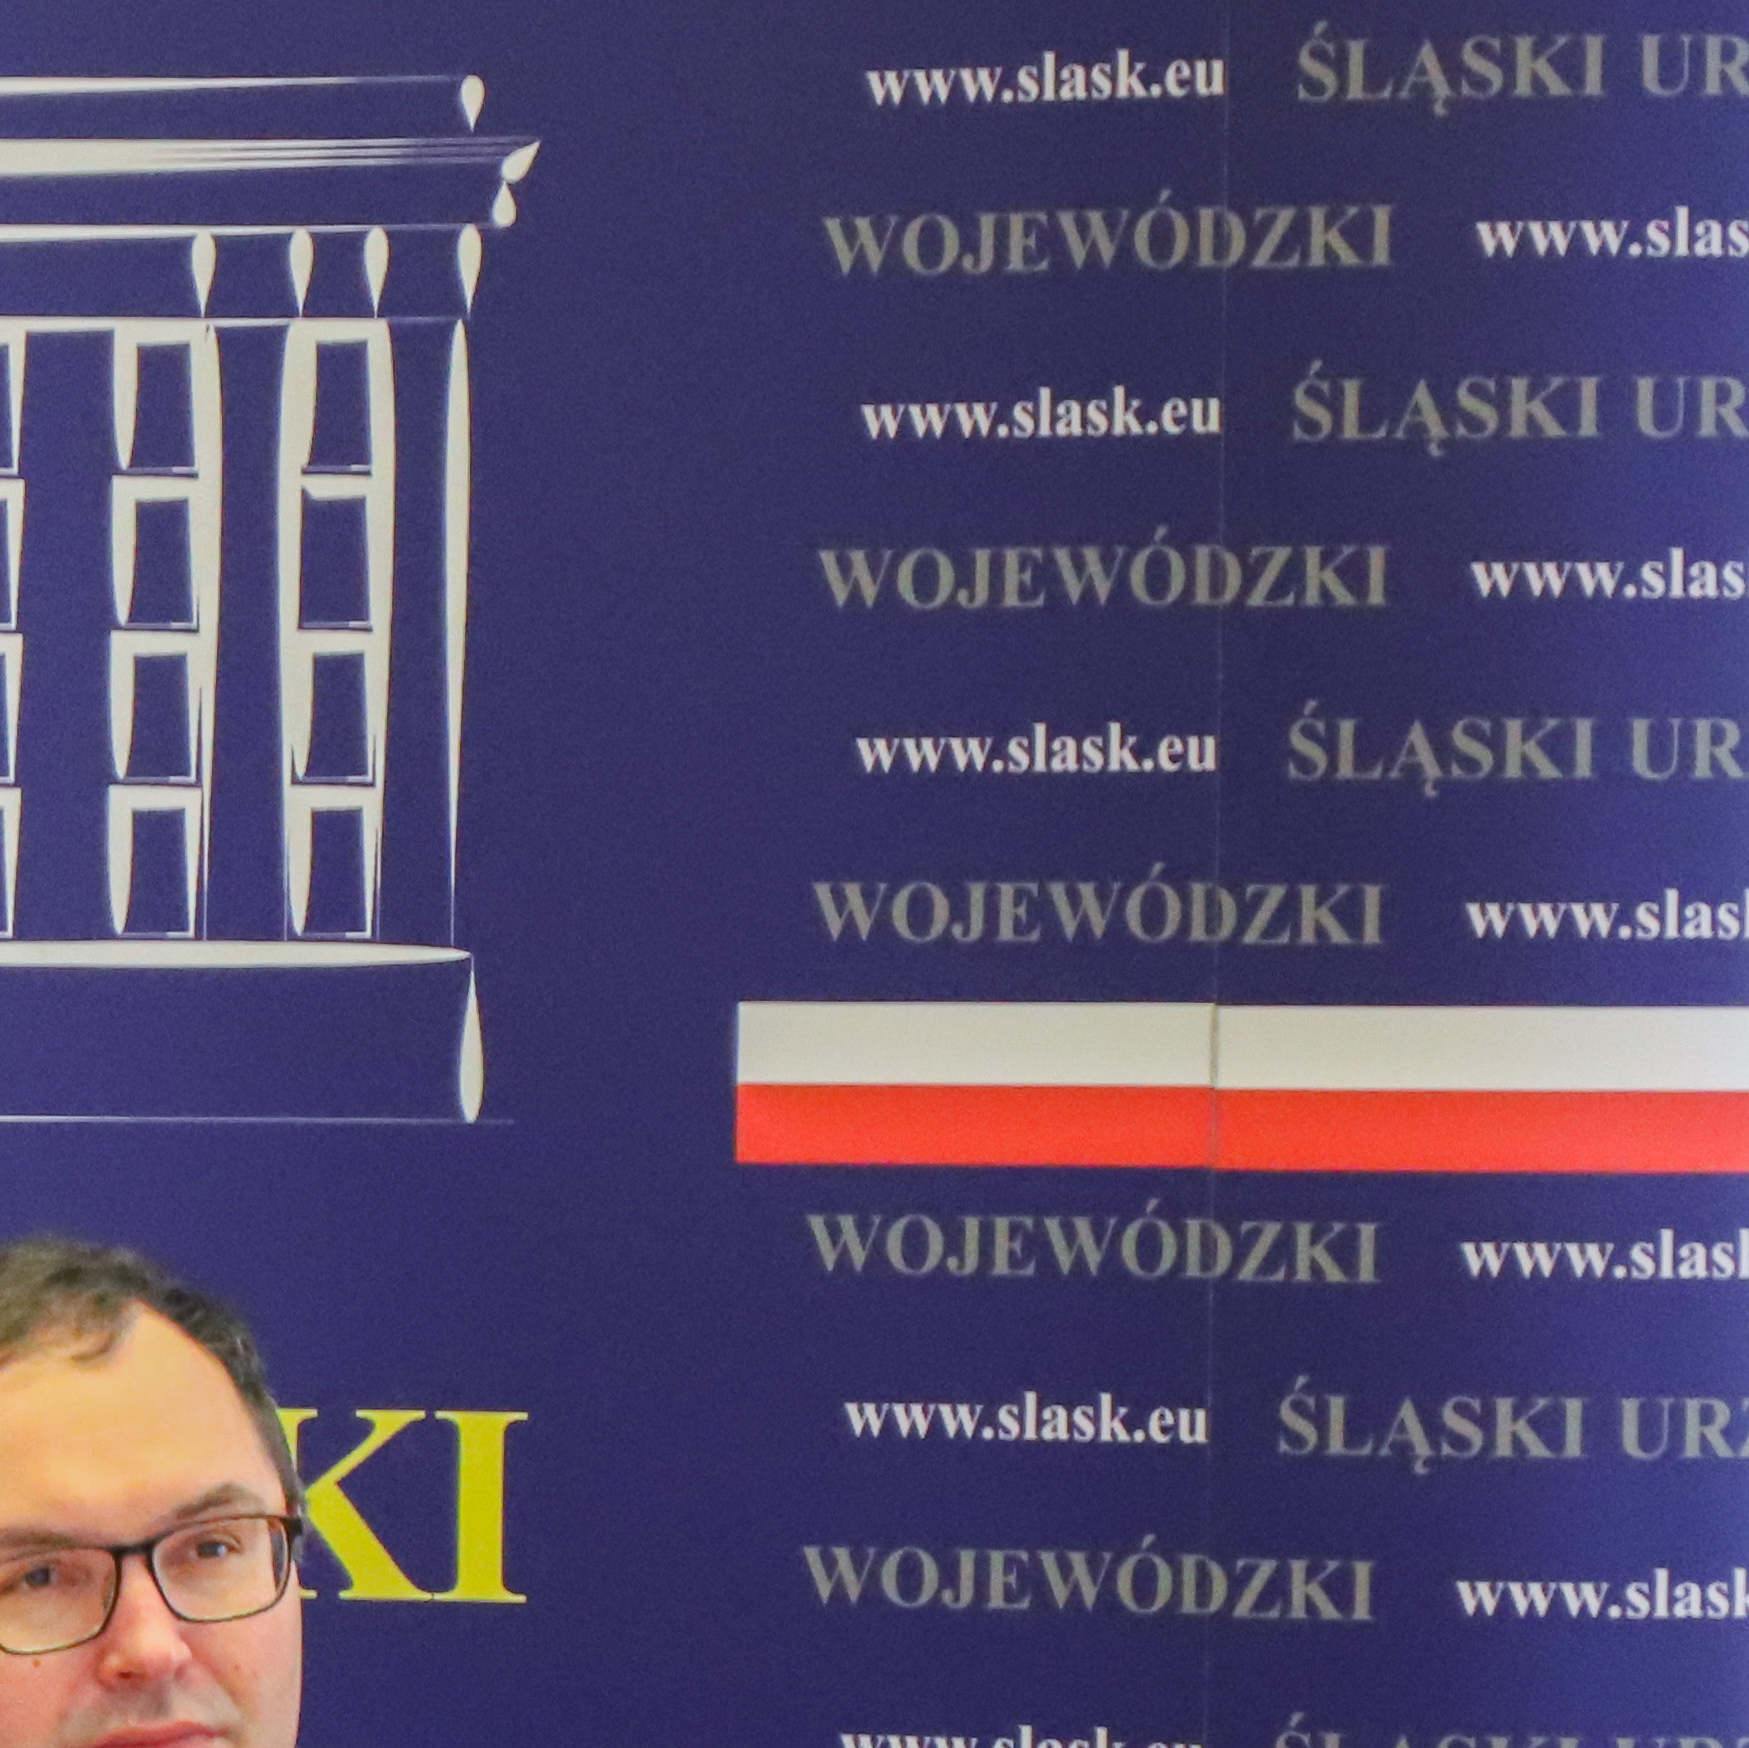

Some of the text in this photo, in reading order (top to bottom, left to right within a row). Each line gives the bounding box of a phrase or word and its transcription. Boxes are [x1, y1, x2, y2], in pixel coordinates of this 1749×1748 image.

[866, 49, 1224, 105] www.slask.eu
[1298, 21, 1605, 117] ŚLĄSKI
[822, 189, 1392, 275] WOJEWÓDZKI
[861, 385, 1220, 439] www.slask.eu
[1294, 360, 1601, 457] ŚLĄSKI
[818, 526, 1387, 610] WOJEWÓDZKI
[856, 722, 1216, 773] www.slask.eu
[1288, 700, 1595, 798] ŚLĄSKI
[813, 862, 1749, 945] WOJEWÓDZKI www.slas
[807, 1198, 1749, 1283] WOJEWÓDZKI www.slas
[844, 1391, 1208, 1444] www.slask.eu
[1279, 1376, 1588, 1475] ŚLĄSKI
[803, 1534, 1373, 1620] WOJEWÓDZKI
